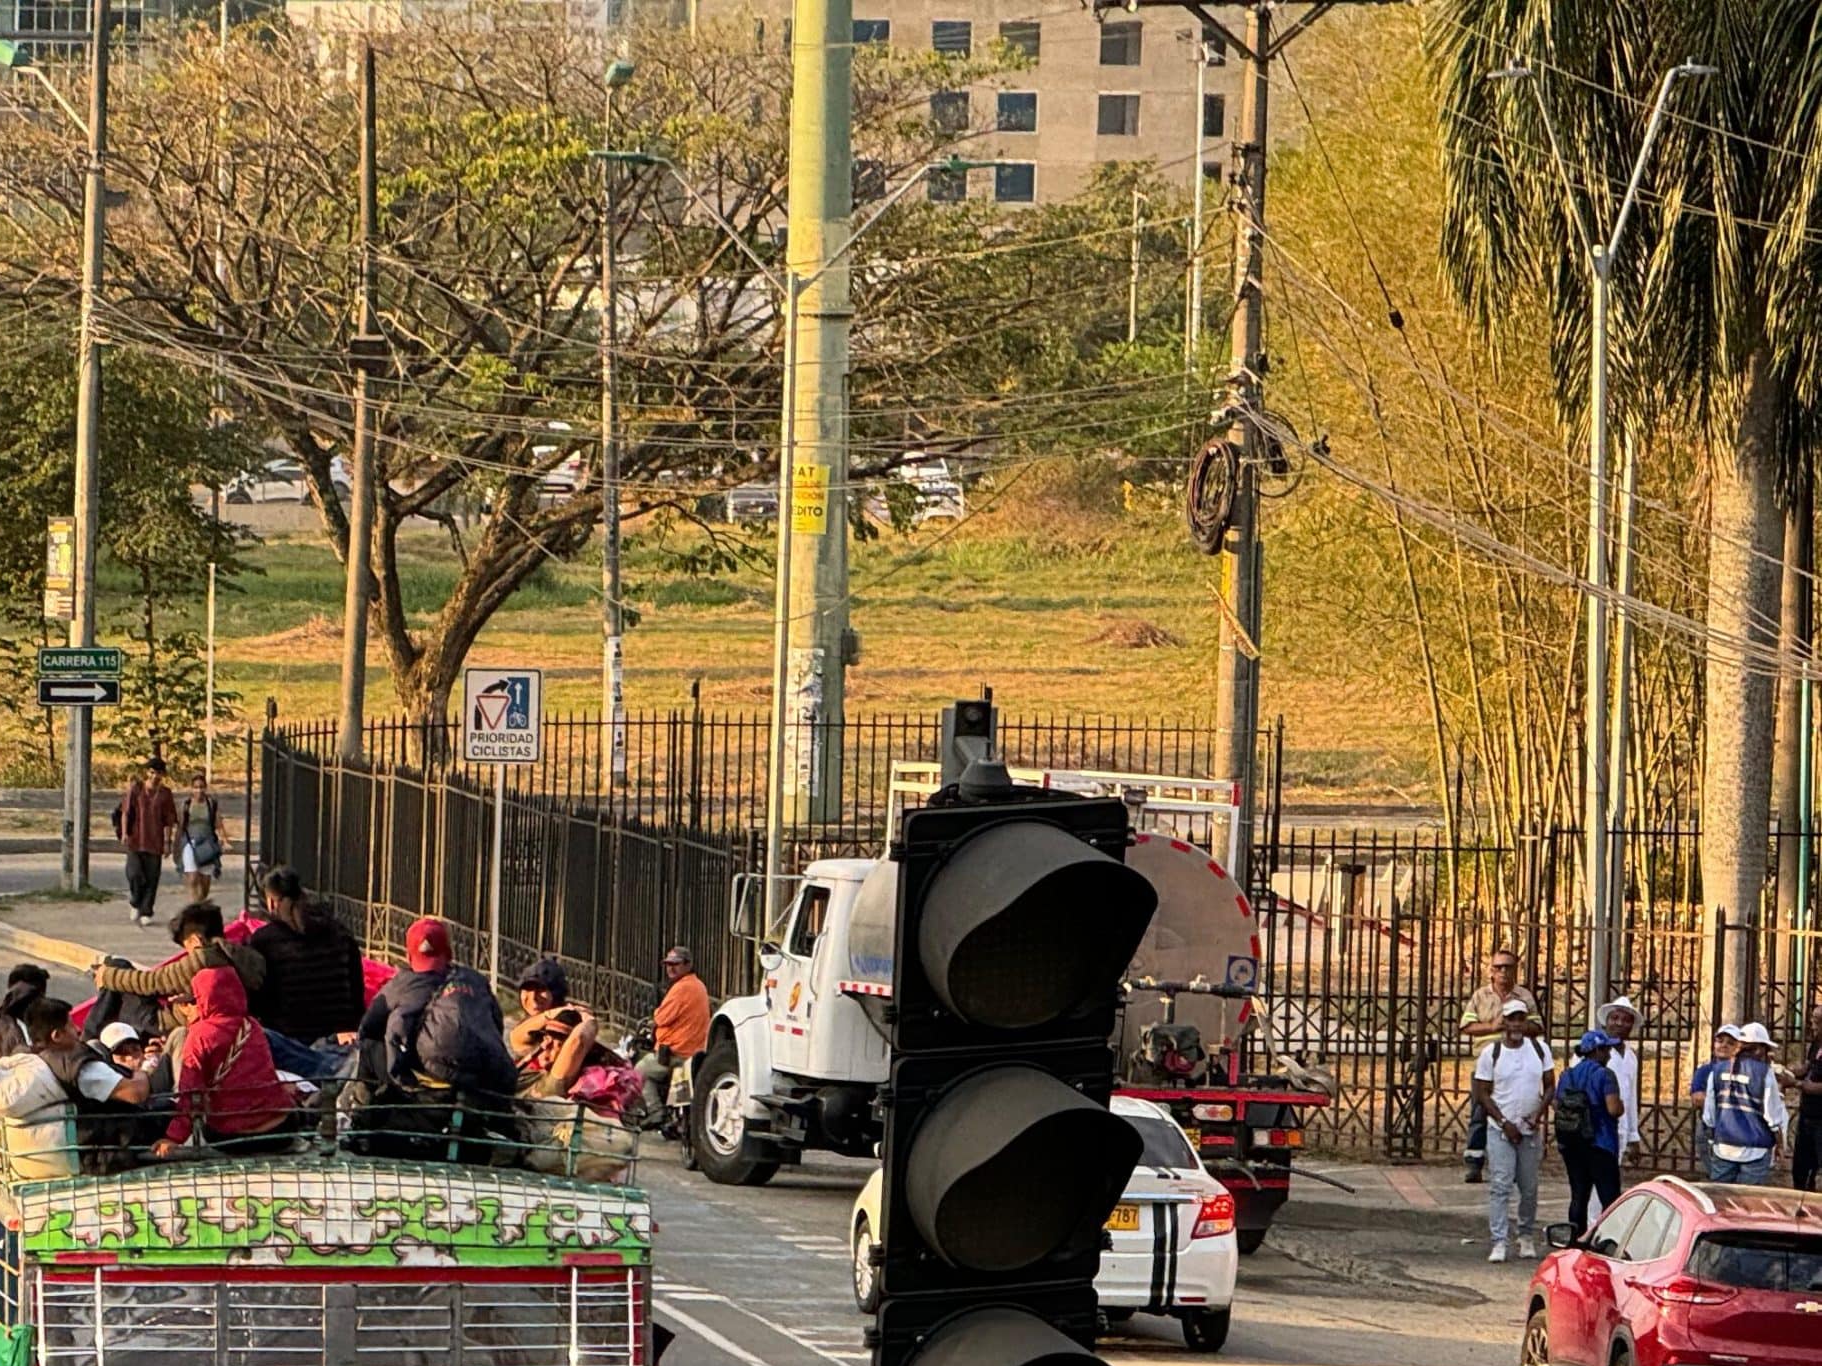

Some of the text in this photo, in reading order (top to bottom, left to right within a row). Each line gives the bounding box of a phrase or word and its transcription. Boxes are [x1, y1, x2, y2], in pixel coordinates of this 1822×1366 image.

[43, 655, 117, 667] CARRERA 115
[469, 732, 534, 744] PRIORIDAD
[472, 745, 531, 757] CICLISTAS
